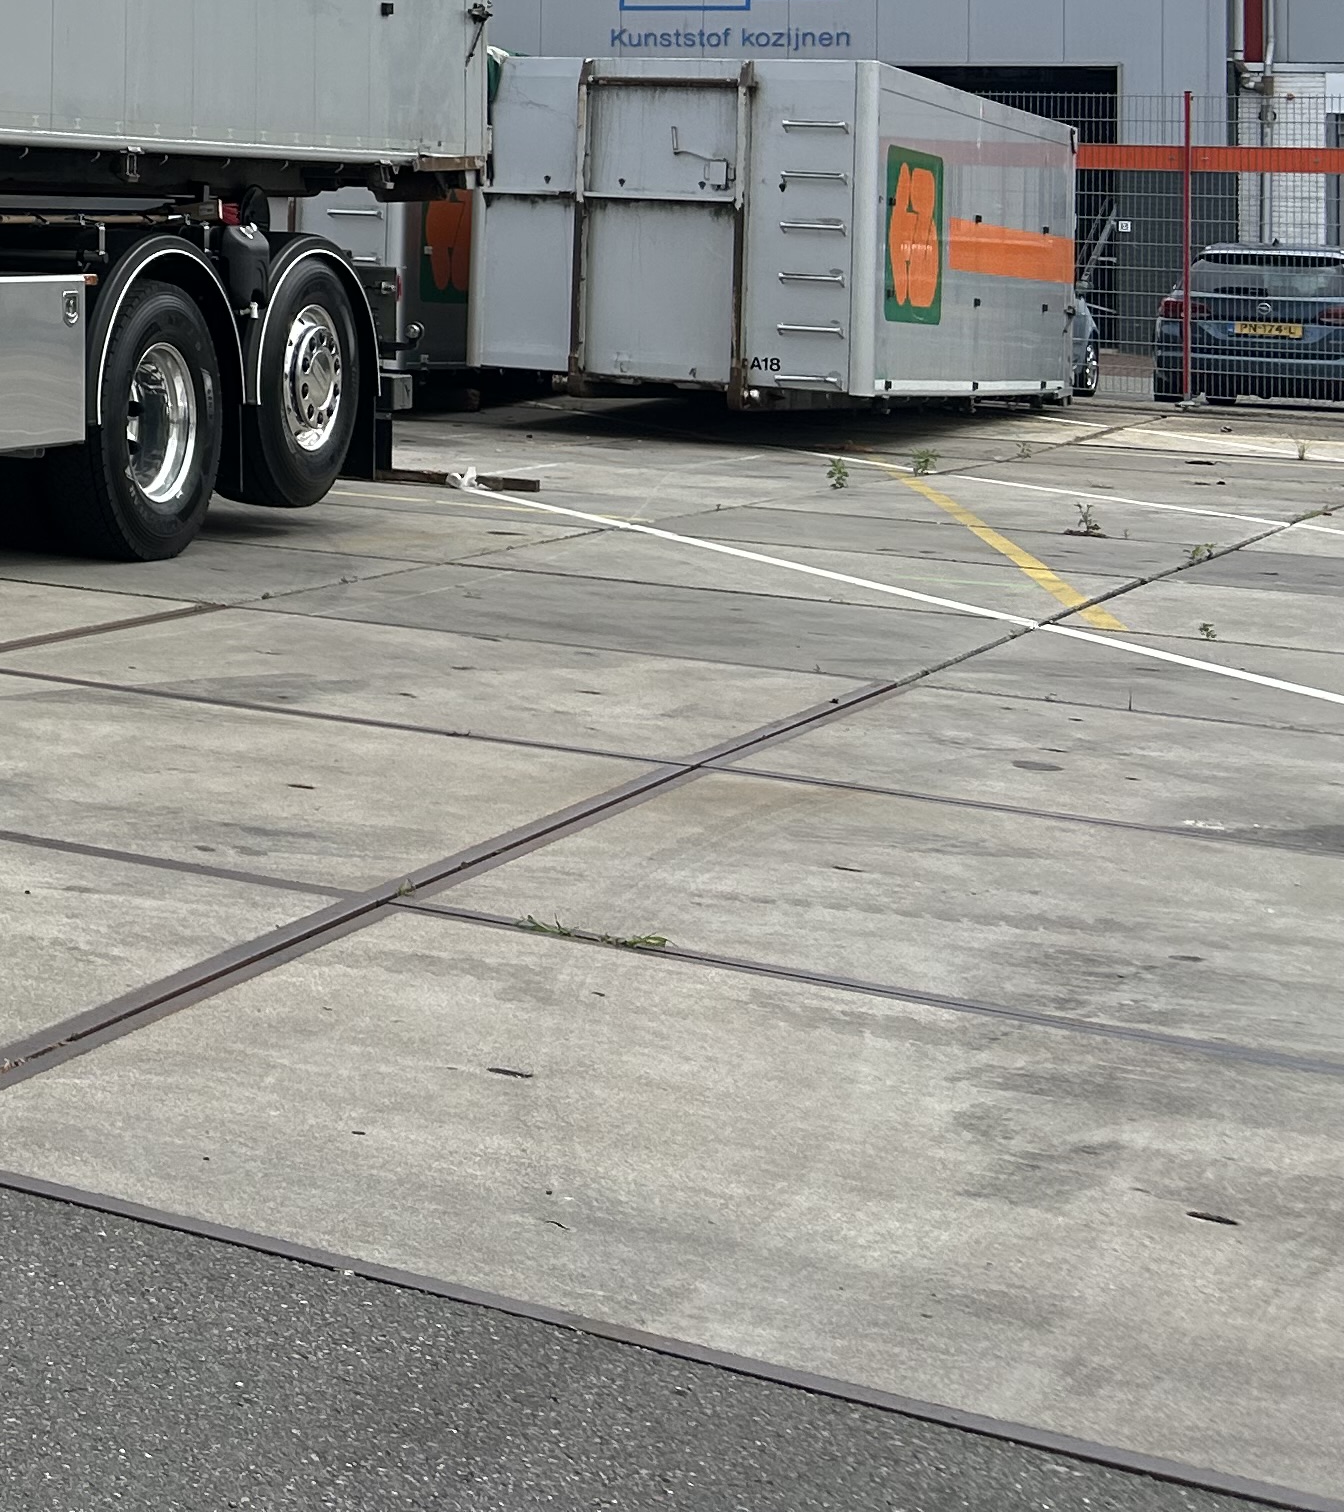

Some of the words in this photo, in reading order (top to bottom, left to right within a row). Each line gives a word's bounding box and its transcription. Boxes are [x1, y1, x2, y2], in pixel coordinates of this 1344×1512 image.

[611, 28, 732, 48] Kunststof
[741, 28, 851, 51] kozijnen
[750, 356, 781, 372] A18
